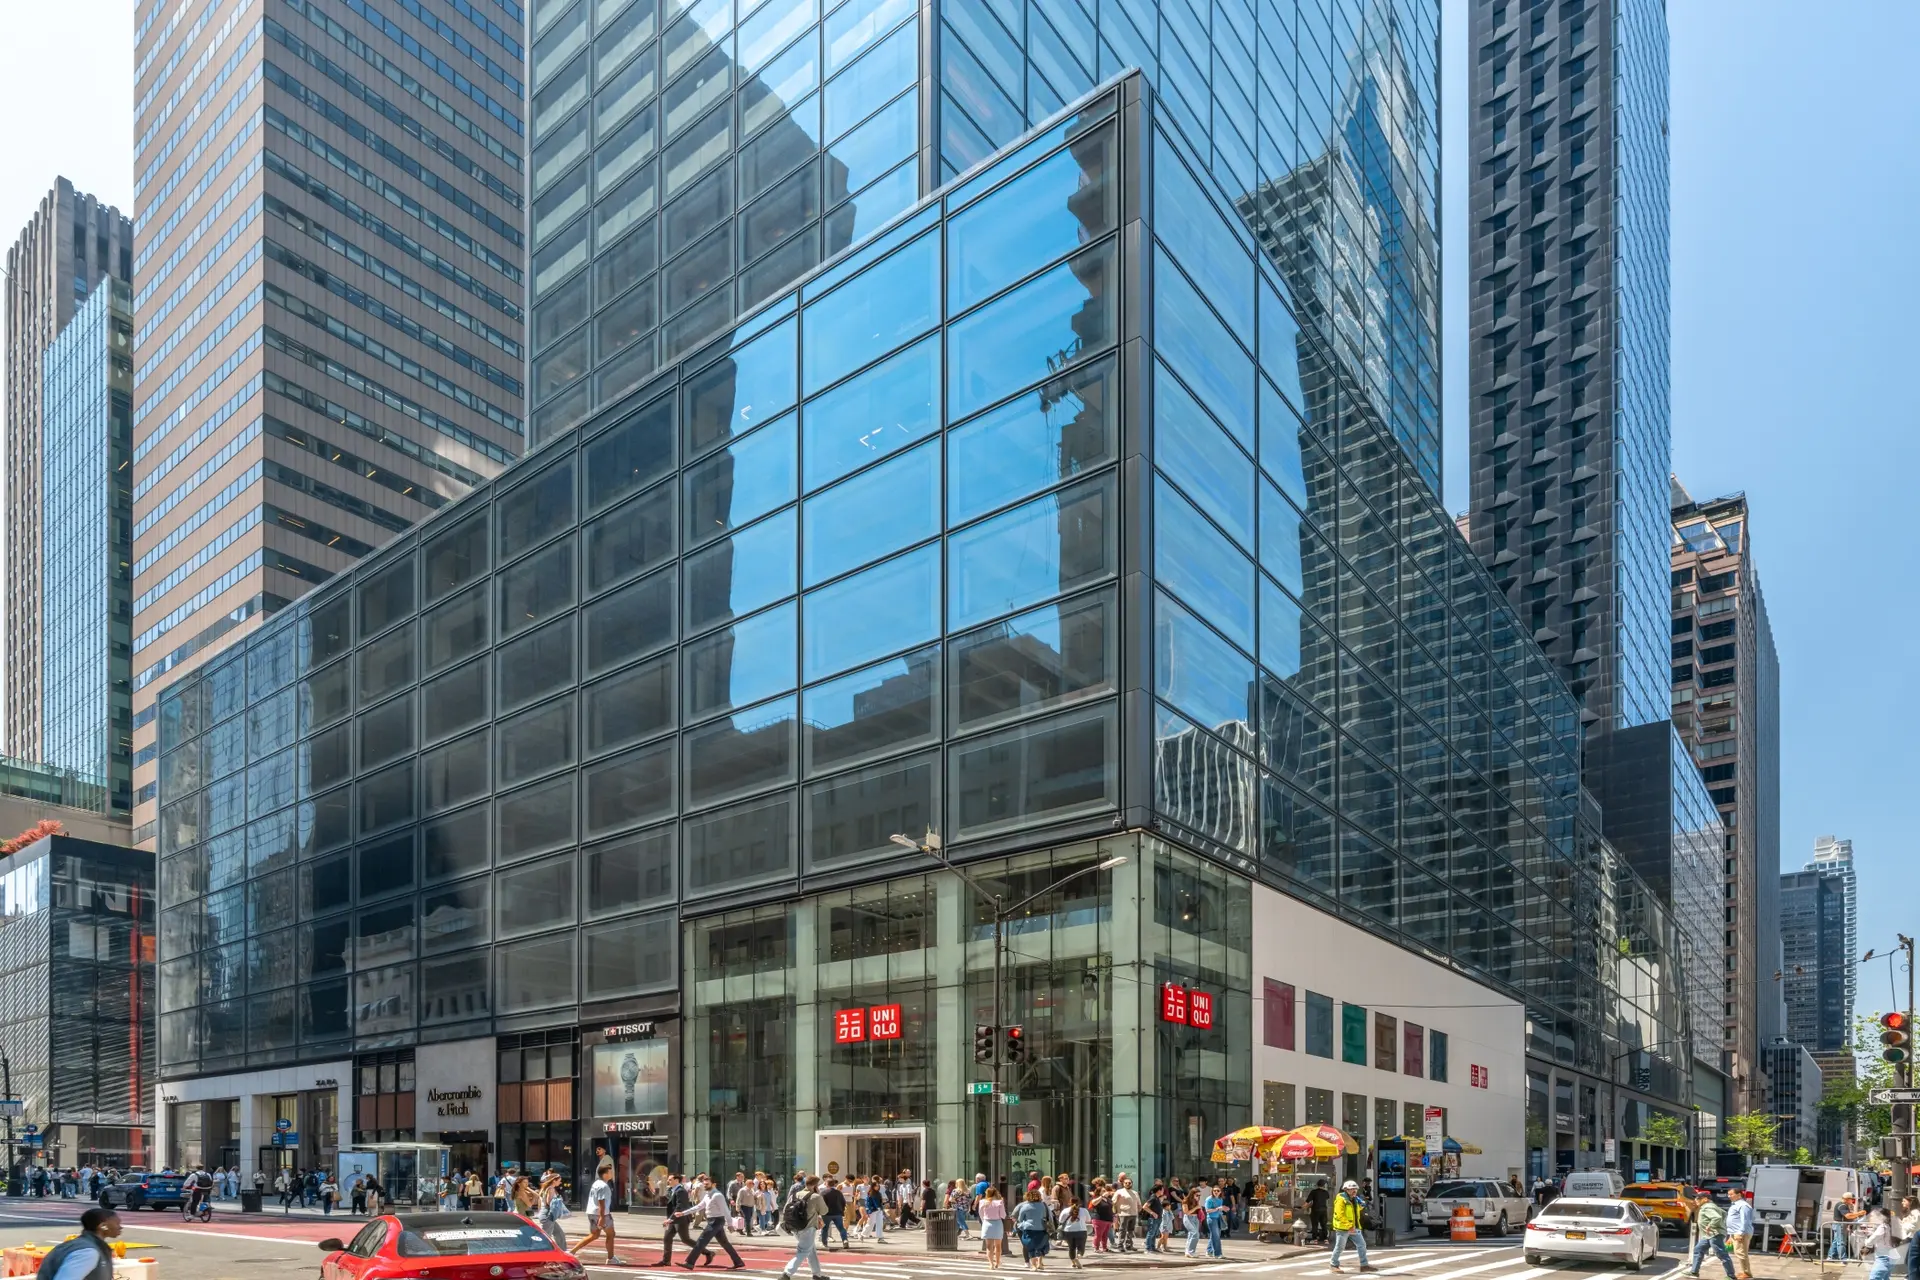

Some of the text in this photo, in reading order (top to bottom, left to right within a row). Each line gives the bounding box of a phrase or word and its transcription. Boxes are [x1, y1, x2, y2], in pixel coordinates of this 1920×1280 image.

[1167, 988, 1184, 1004] ユニ
[1193, 994, 1209, 1010] UNI
[873, 1008, 895, 1022] UNI
[1167, 1003, 1184, 1019] クロ
[1193, 1009, 1210, 1025] QLO
[839, 1012, 861, 1026] ユニ
[616, 1021, 654, 1036] TISSOT
[839, 1026, 861, 1040] クロ
[873, 1022, 897, 1038] QLO
[427, 1085, 482, 1103] Abercrombie
[977, 1084, 983, 1093] 5
[437, 1102, 469, 1117] & Fitch
[616, 1120, 652, 1132] TISSOT
